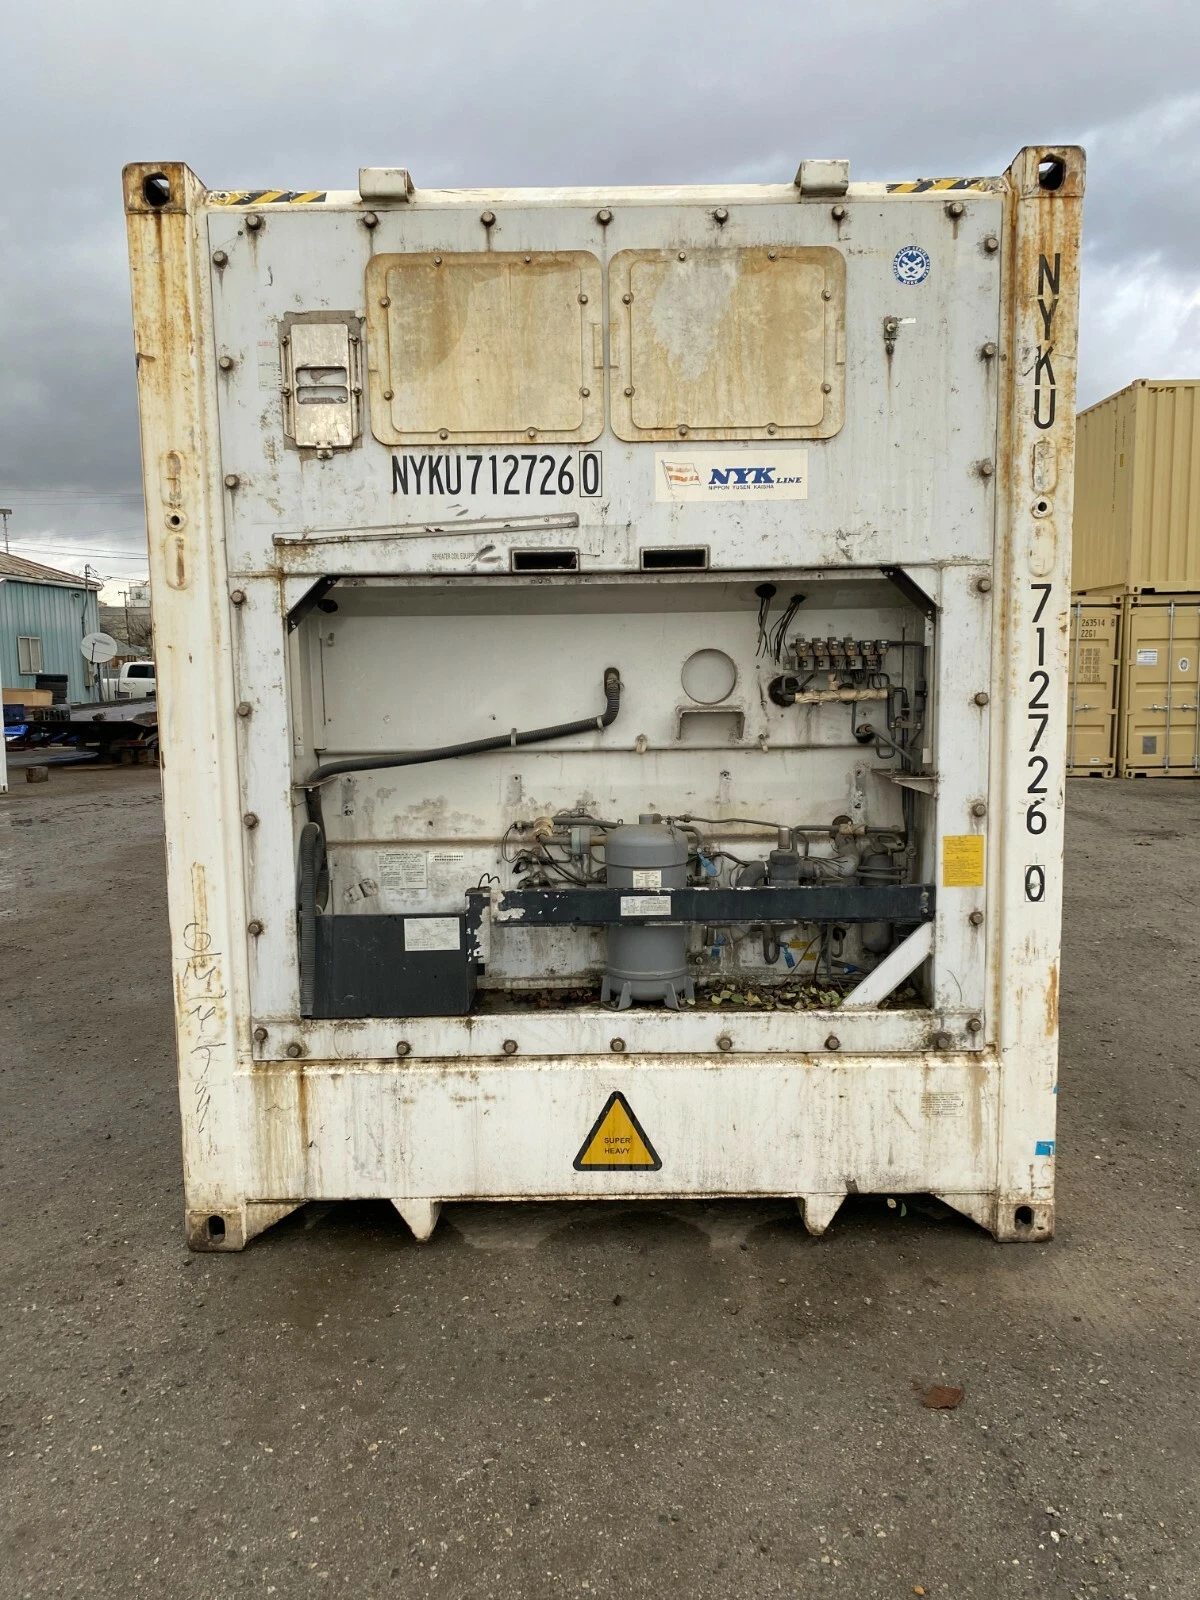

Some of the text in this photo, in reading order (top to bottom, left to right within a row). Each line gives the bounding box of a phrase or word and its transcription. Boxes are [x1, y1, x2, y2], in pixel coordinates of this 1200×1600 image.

[391, 452, 600, 495] NYKU712726 0
[708, 467, 802, 484] NYK LINE
[1024, 253, 1060, 902] NYKU 712726 0
[1081, 618, 1105, 627] 263514
[1080, 629, 1096, 638] 22G1
